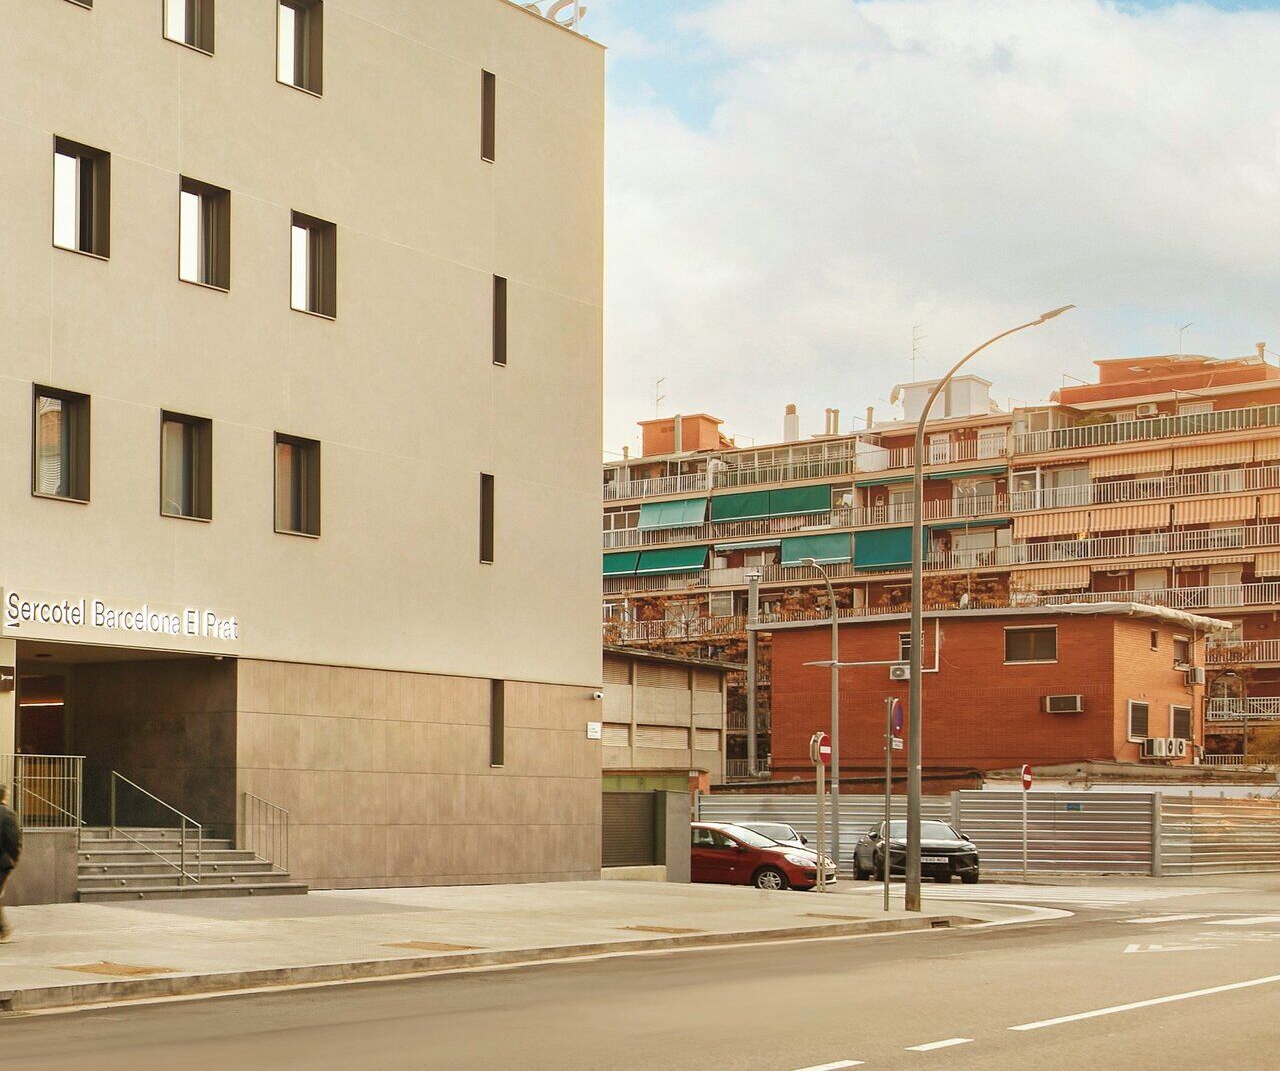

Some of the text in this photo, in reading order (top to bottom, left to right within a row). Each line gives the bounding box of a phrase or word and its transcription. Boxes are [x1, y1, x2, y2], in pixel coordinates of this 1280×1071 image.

[6, 592, 239, 640] Sercotel Barcelona El Prat
